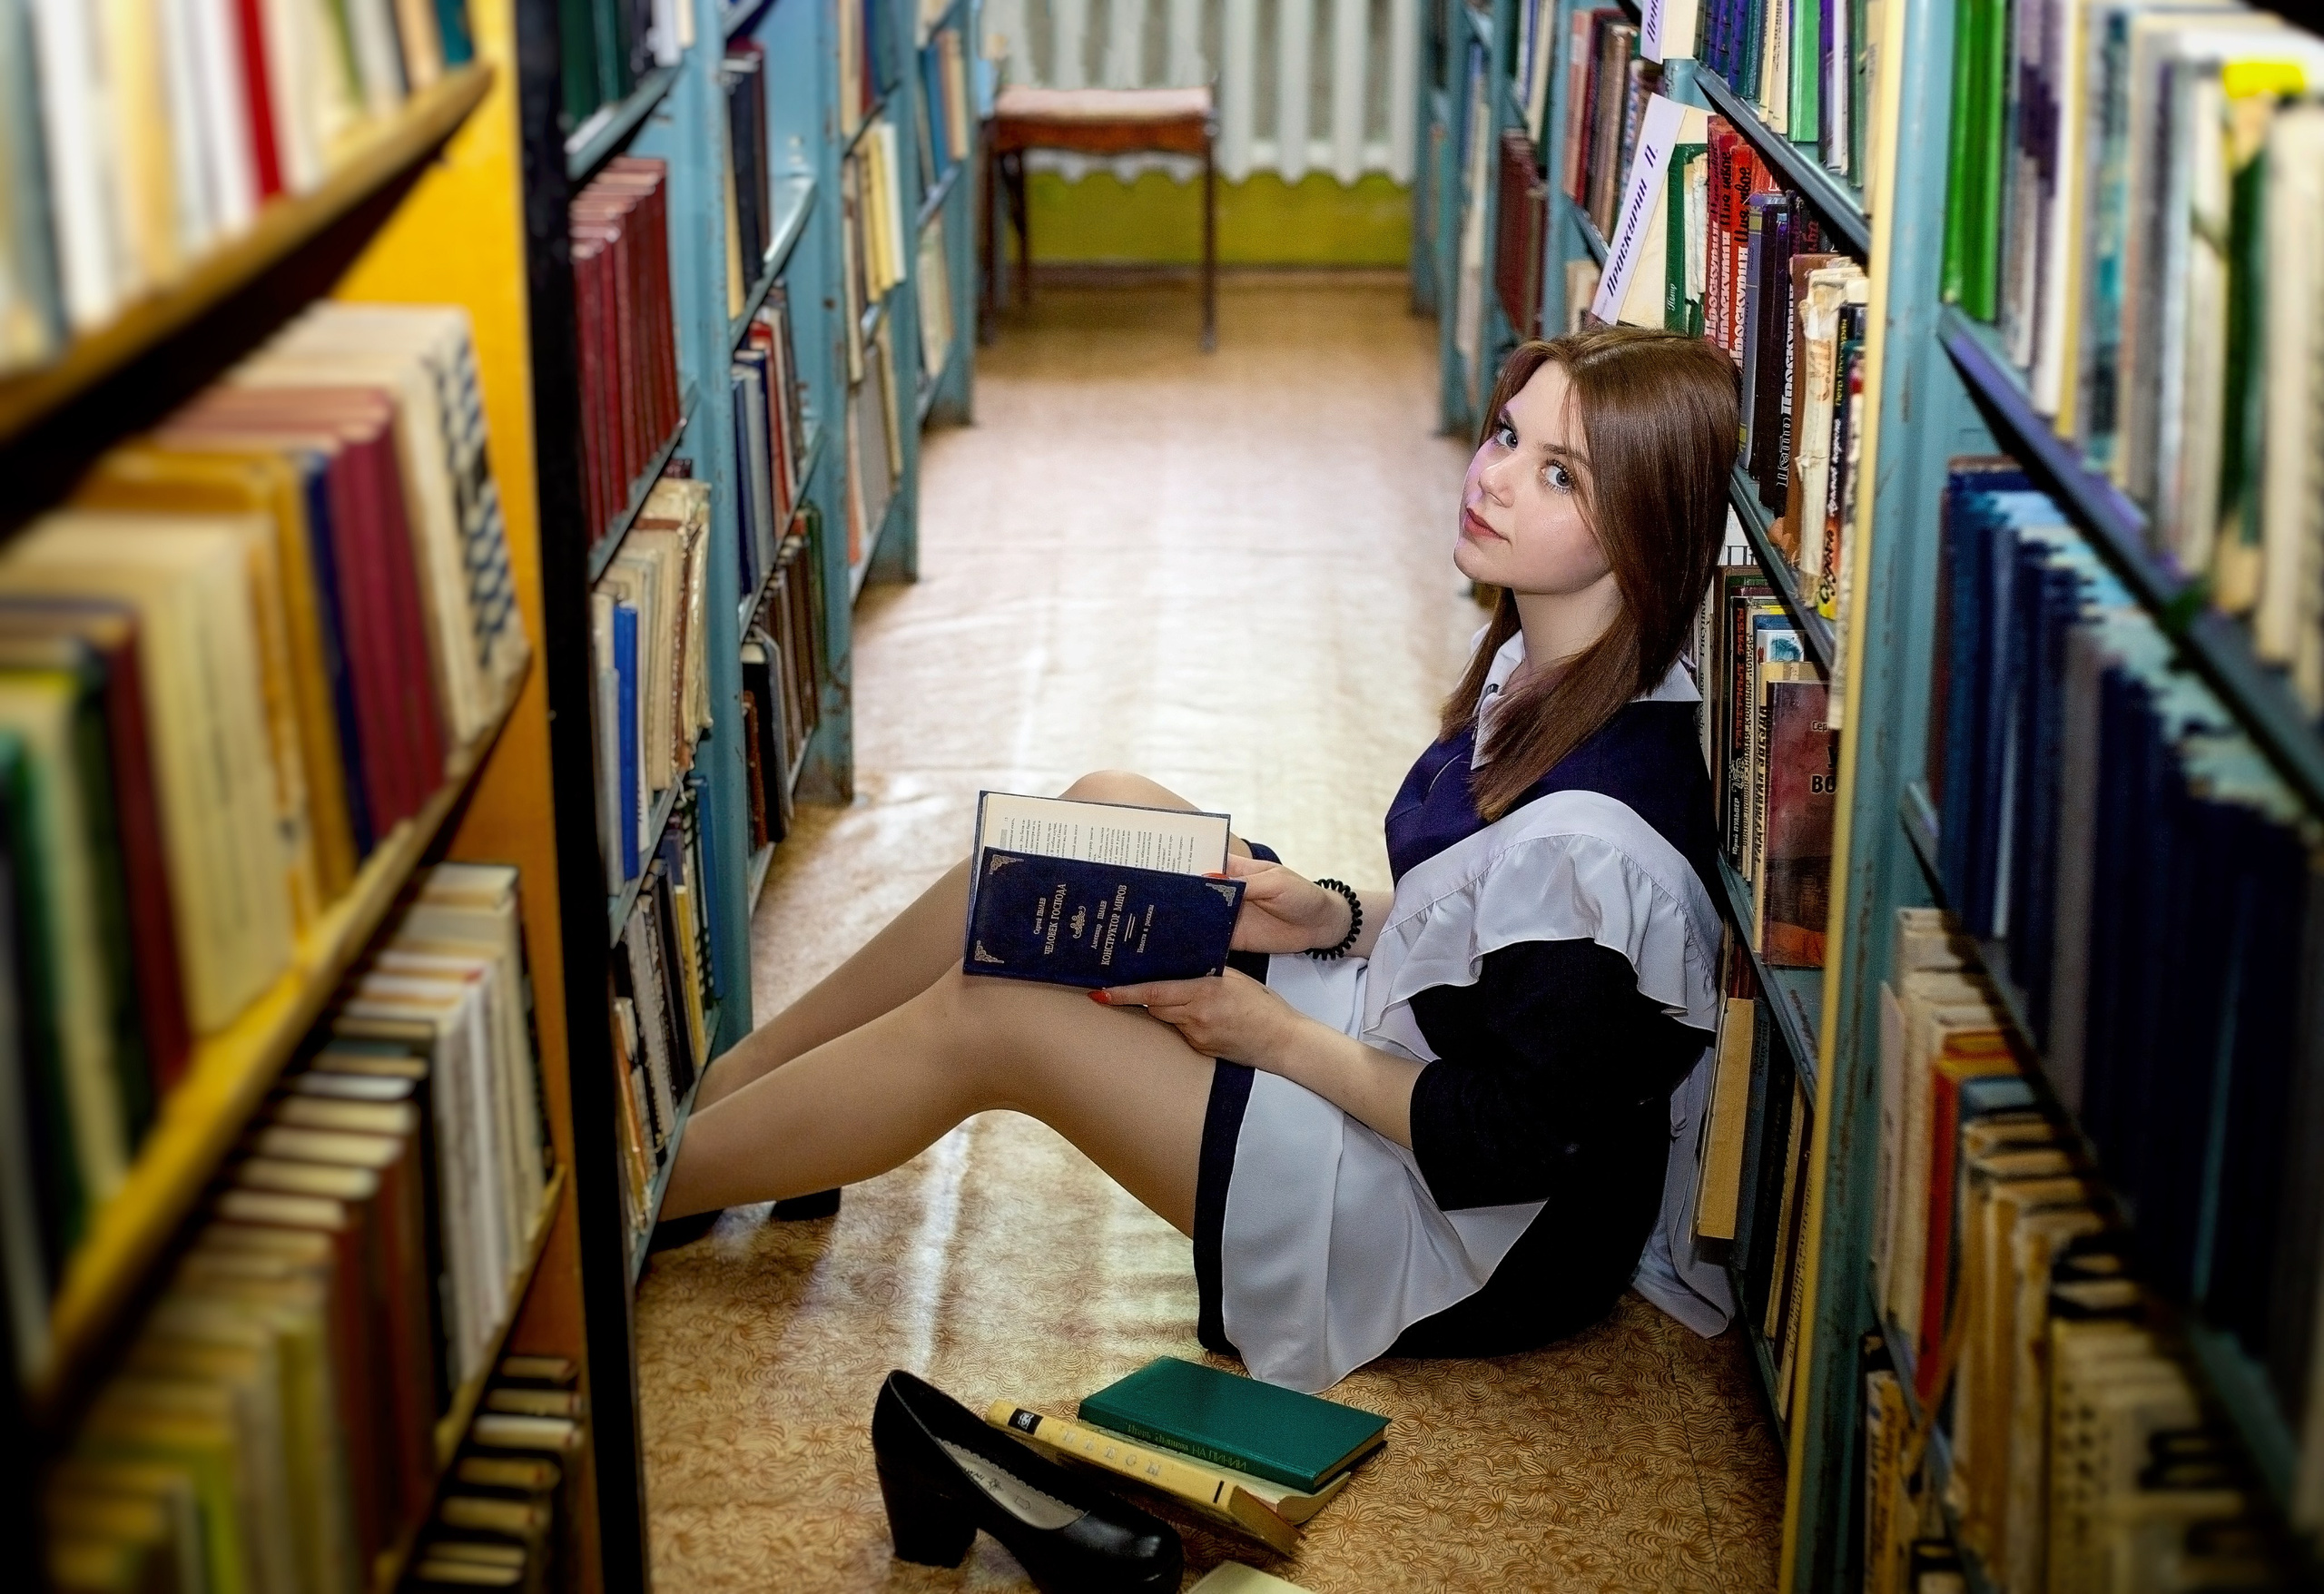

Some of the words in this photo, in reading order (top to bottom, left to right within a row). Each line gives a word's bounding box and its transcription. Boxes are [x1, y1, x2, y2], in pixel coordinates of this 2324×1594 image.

[1606, 178, 1648, 298] Проскурин
[1646, 143, 1659, 170] П.
[1737, 606, 1745, 656] РАБЫ
[1735, 662, 1745, 750] ГАЛЕРНЫЕ
[1050, 883, 1067, 920] ГОСПОДА
[1033, 918, 1043, 935] Сергей
[1044, 921, 1059, 955] ЧЕЛОВЕК
[1101, 913, 1121, 966] КОНСТРУКТОР
[1113, 884, 1128, 912] МИРОВ
[1192, 1444, 1206, 1457] НА
[1208, 1450, 1247, 1471] ЛИНИИ
